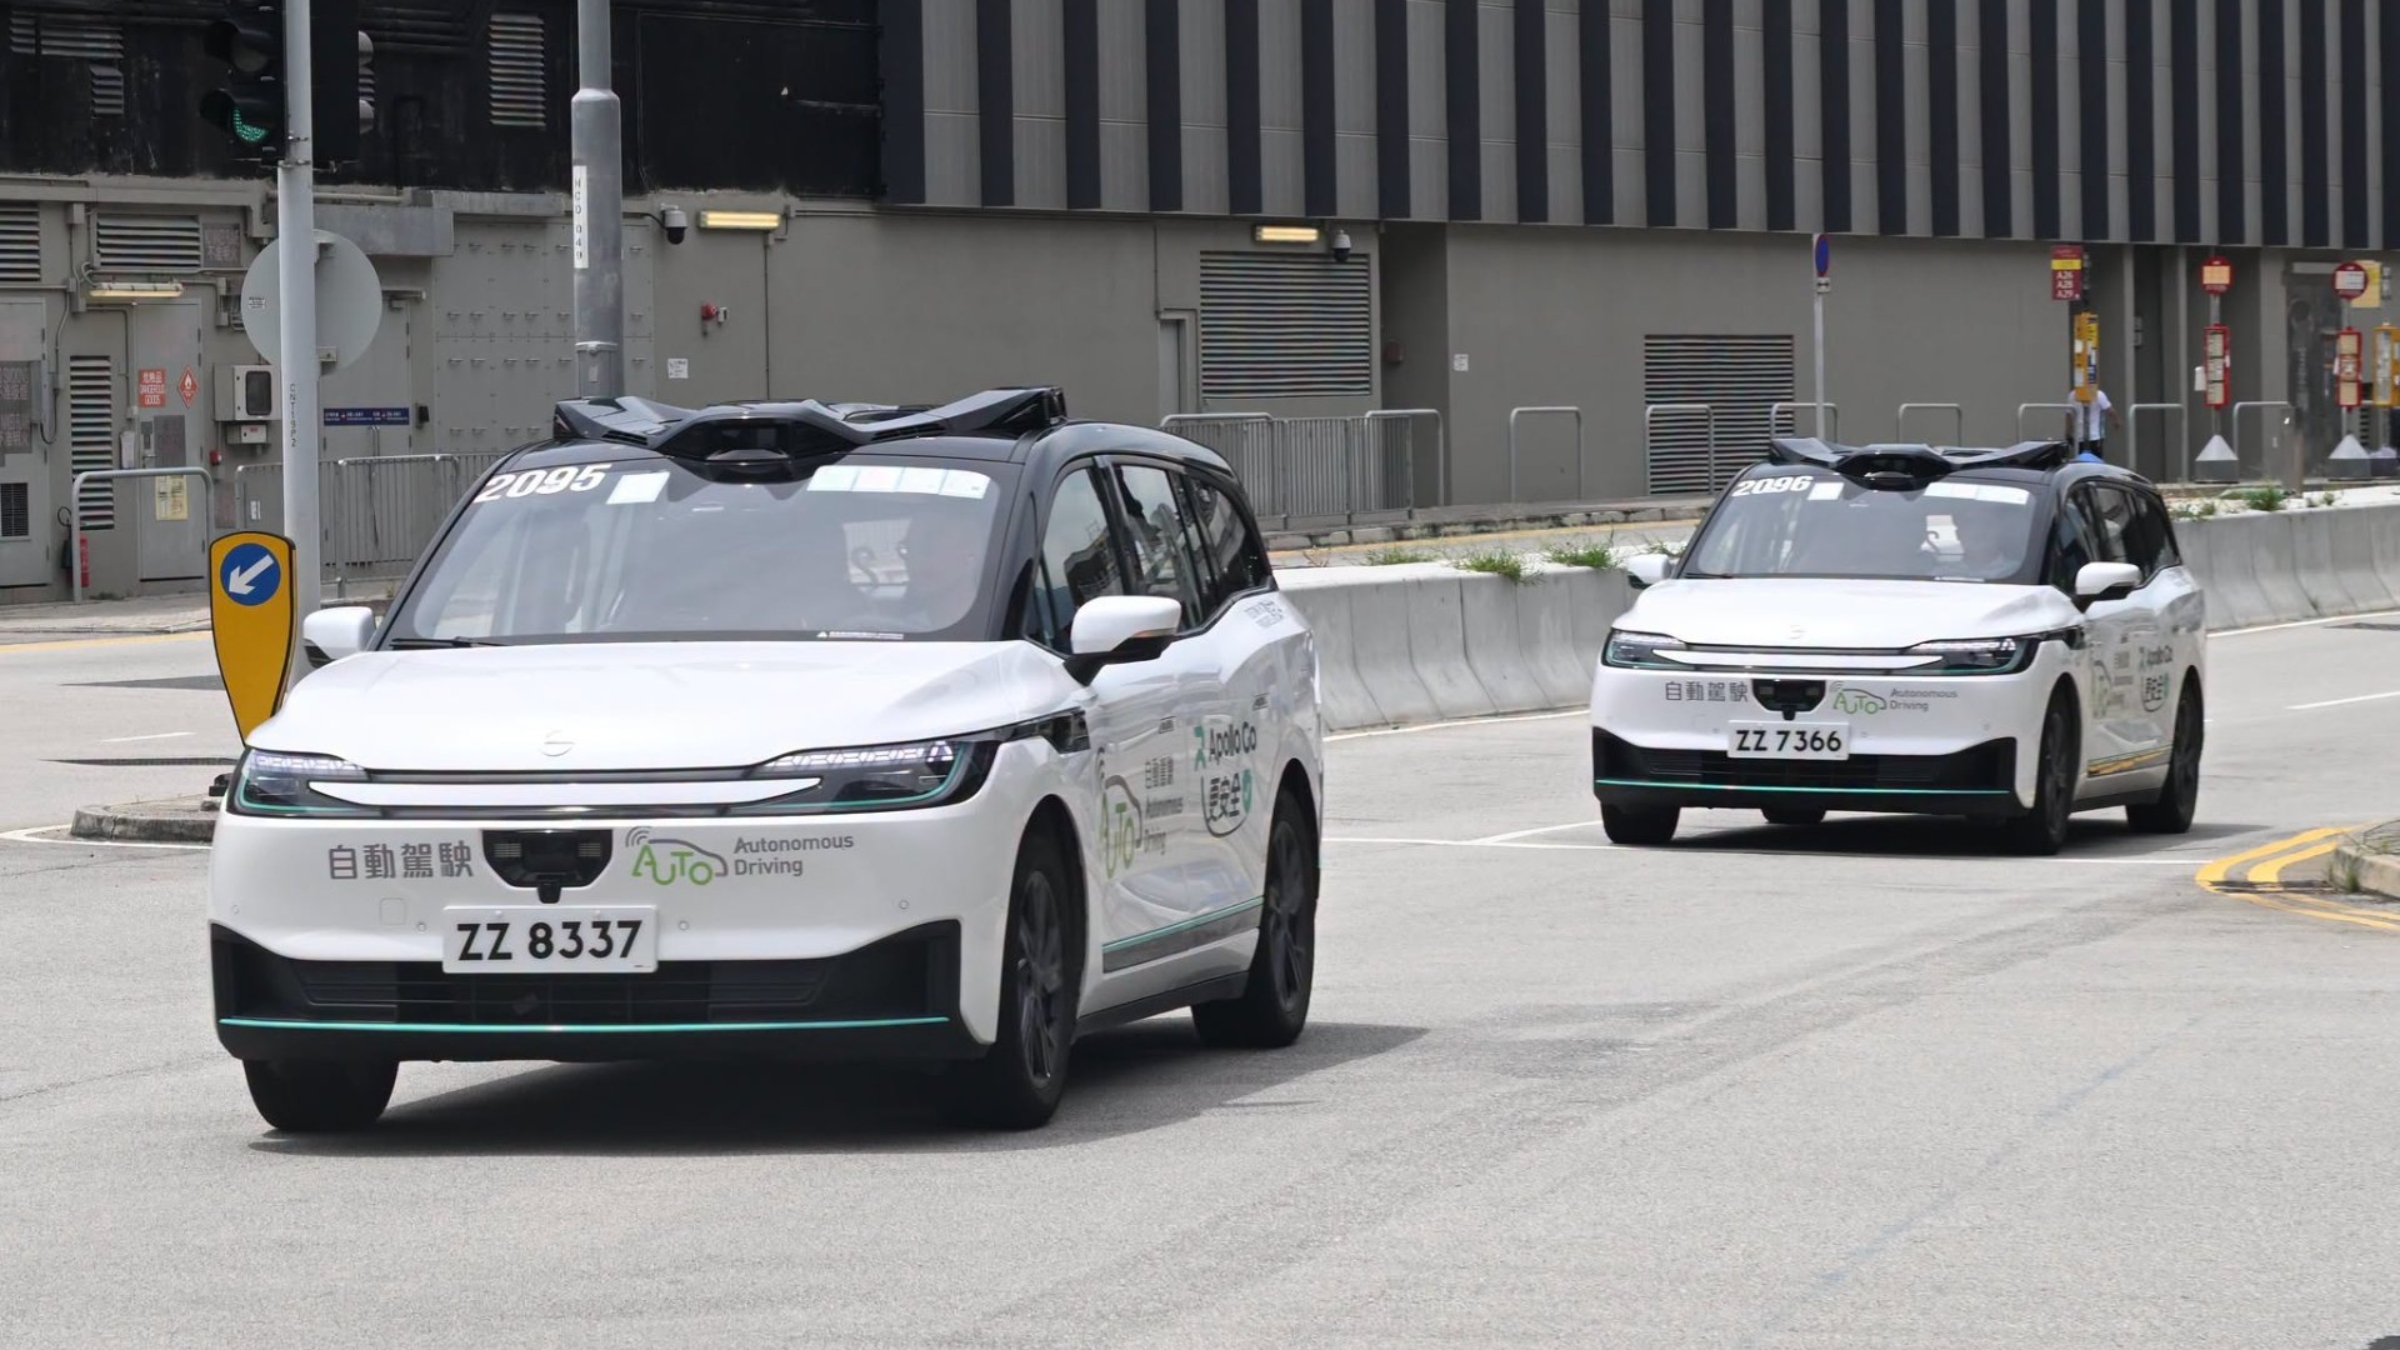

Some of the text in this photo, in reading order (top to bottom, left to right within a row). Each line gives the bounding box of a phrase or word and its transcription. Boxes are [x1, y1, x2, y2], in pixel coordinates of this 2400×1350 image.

[473, 463, 613, 504] 2095
[1731, 475, 1814, 497] 2096
[1665, 681, 1748, 702] 自動駕駛
[1890, 688, 1957, 698] Autonomous
[1889, 700, 1929, 712] Driving
[1208, 721, 1257, 764] Apollo Go
[1735, 730, 1842, 752] ZZ 7366
[733, 835, 855, 854] Autonomous
[328, 840, 474, 880] 自動駕駛
[632, 844, 714, 886] AUTO
[734, 858, 803, 877] Driving
[457, 920, 643, 961] ZZ 8337
